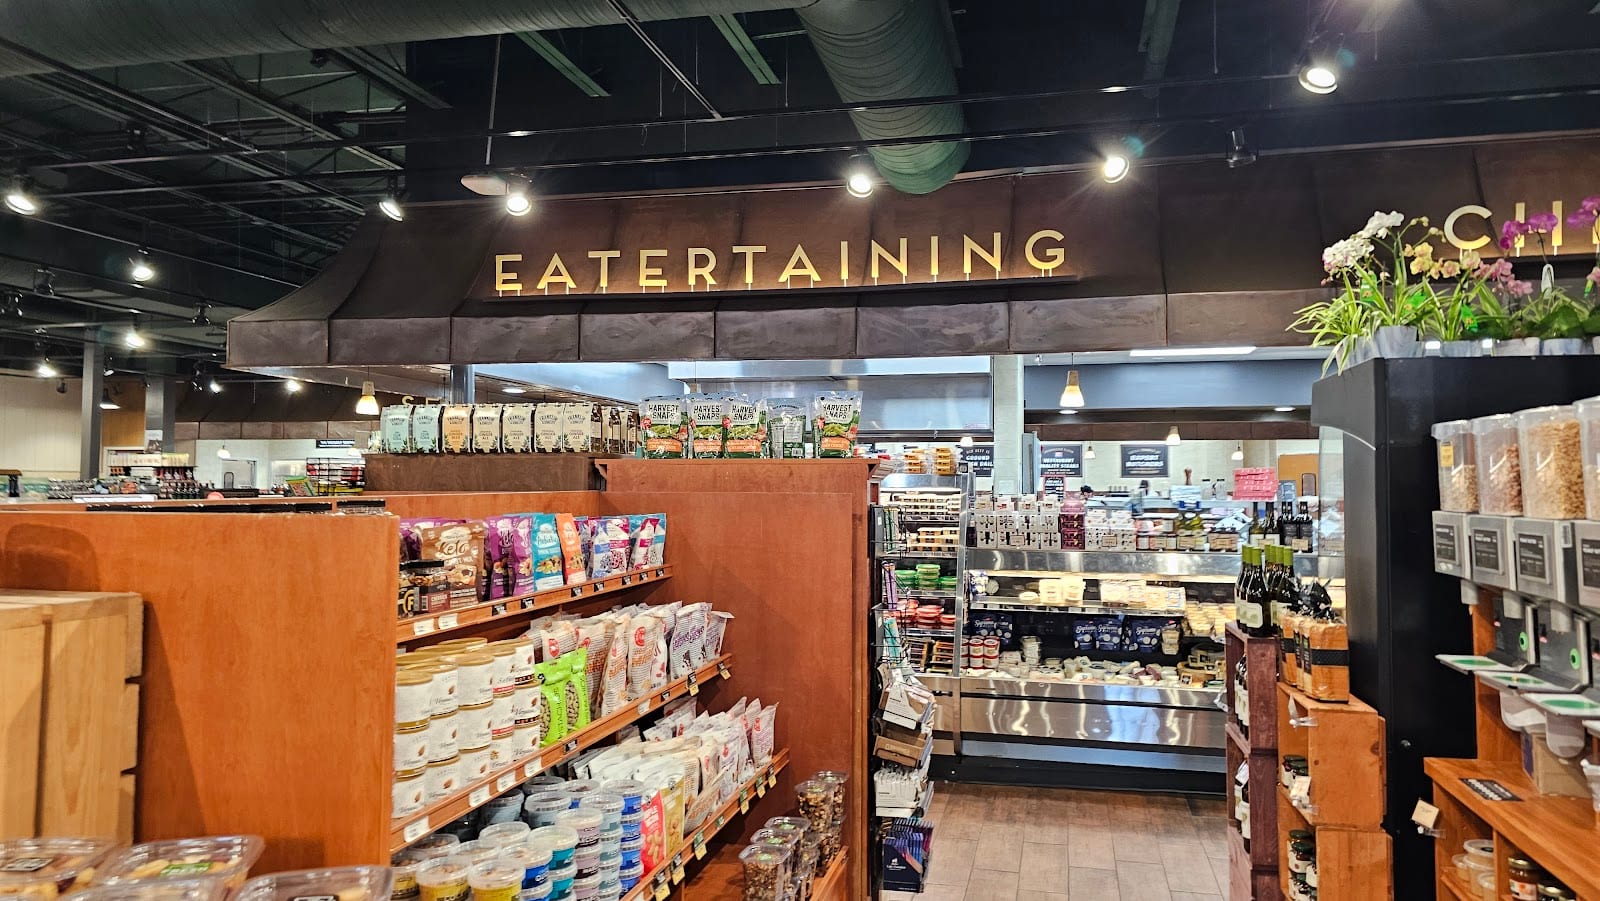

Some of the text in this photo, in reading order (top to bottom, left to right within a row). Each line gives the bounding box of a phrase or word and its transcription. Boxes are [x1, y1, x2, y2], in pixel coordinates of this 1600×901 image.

[495, 229, 1066, 292] EATERTAINING
[648, 404, 680, 413] HARVEST
[822, 404, 853, 413] HARVEST
[697, 412, 720, 421] SNAPS
[439, 540, 467, 556] Keto
